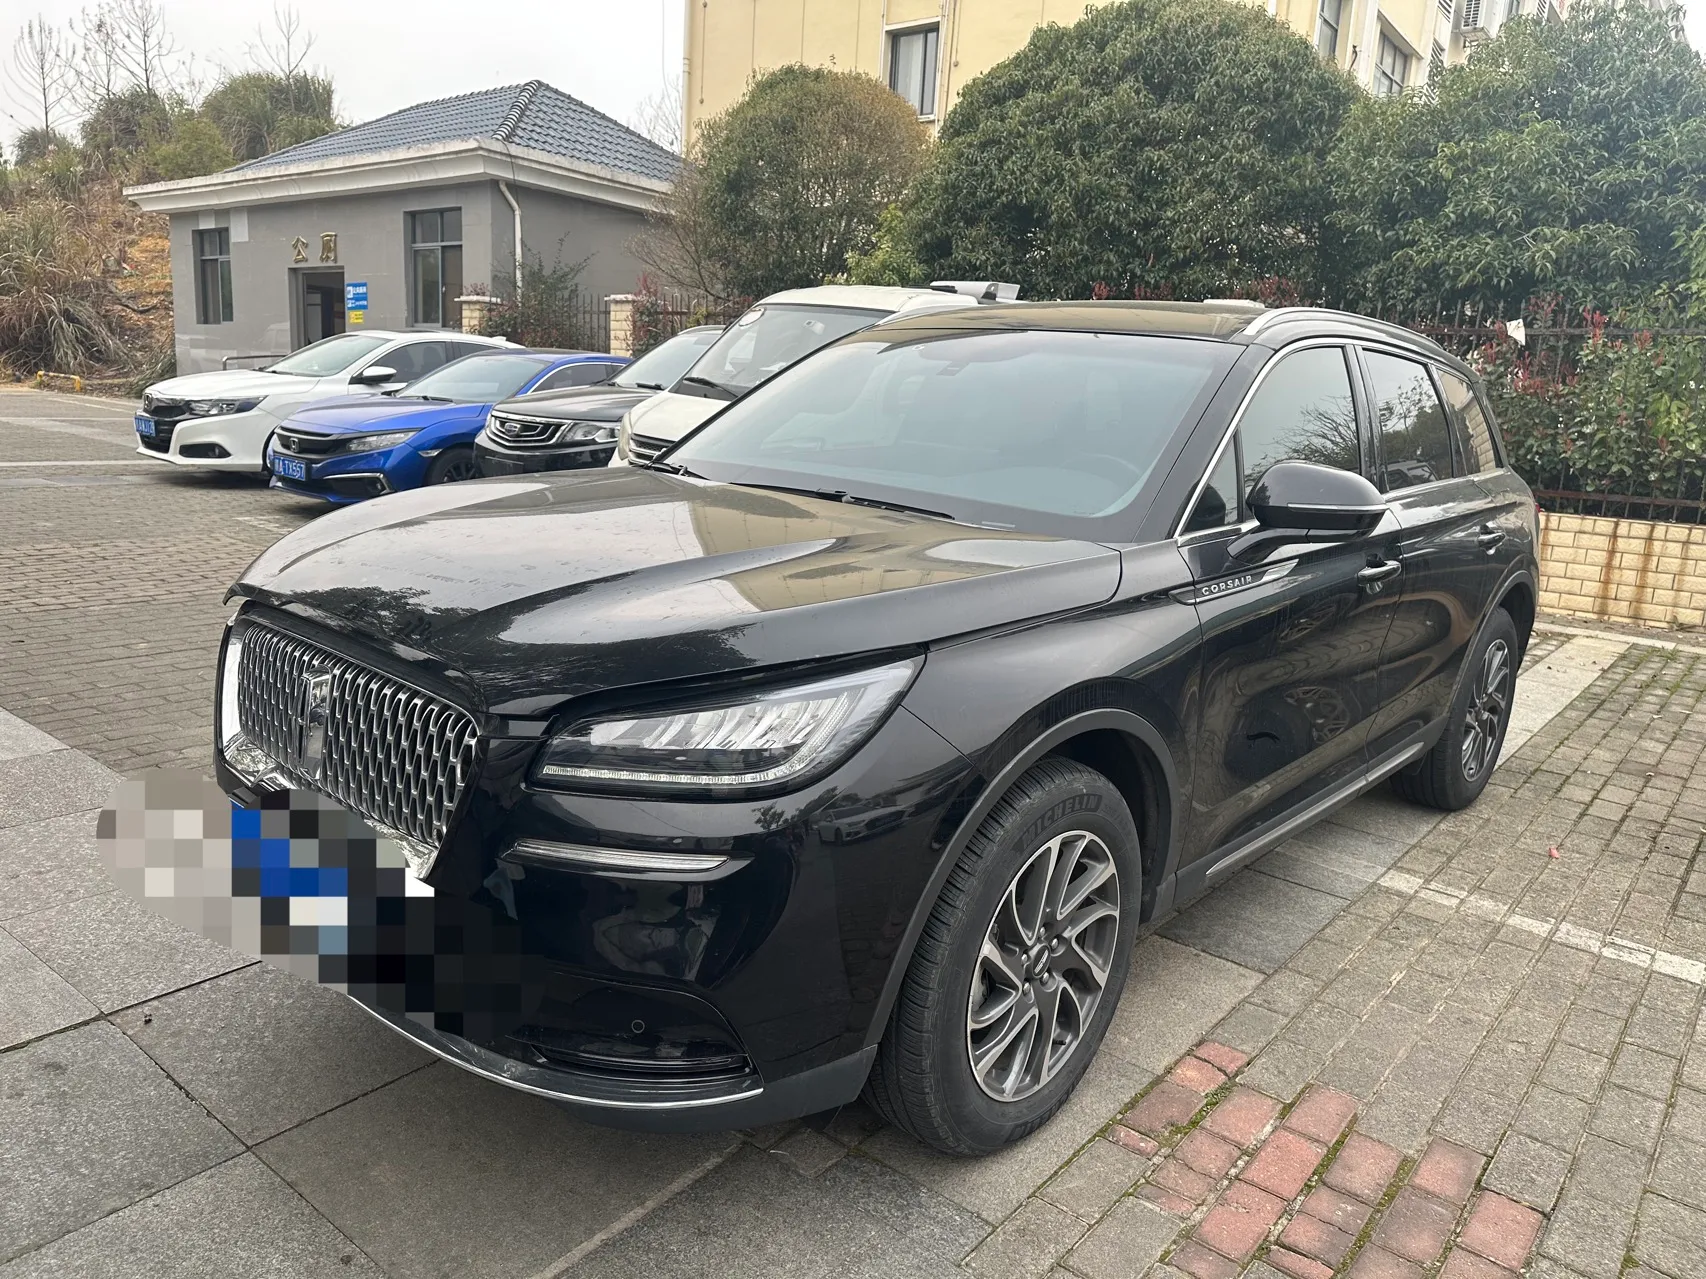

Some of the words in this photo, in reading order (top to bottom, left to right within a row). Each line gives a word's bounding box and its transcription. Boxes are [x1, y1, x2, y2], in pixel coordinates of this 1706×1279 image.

[292, 232, 337, 263] 公厕
[1202, 575, 1252, 595] CORSAIR
[1022, 794, 1099, 849] MICHELIN
